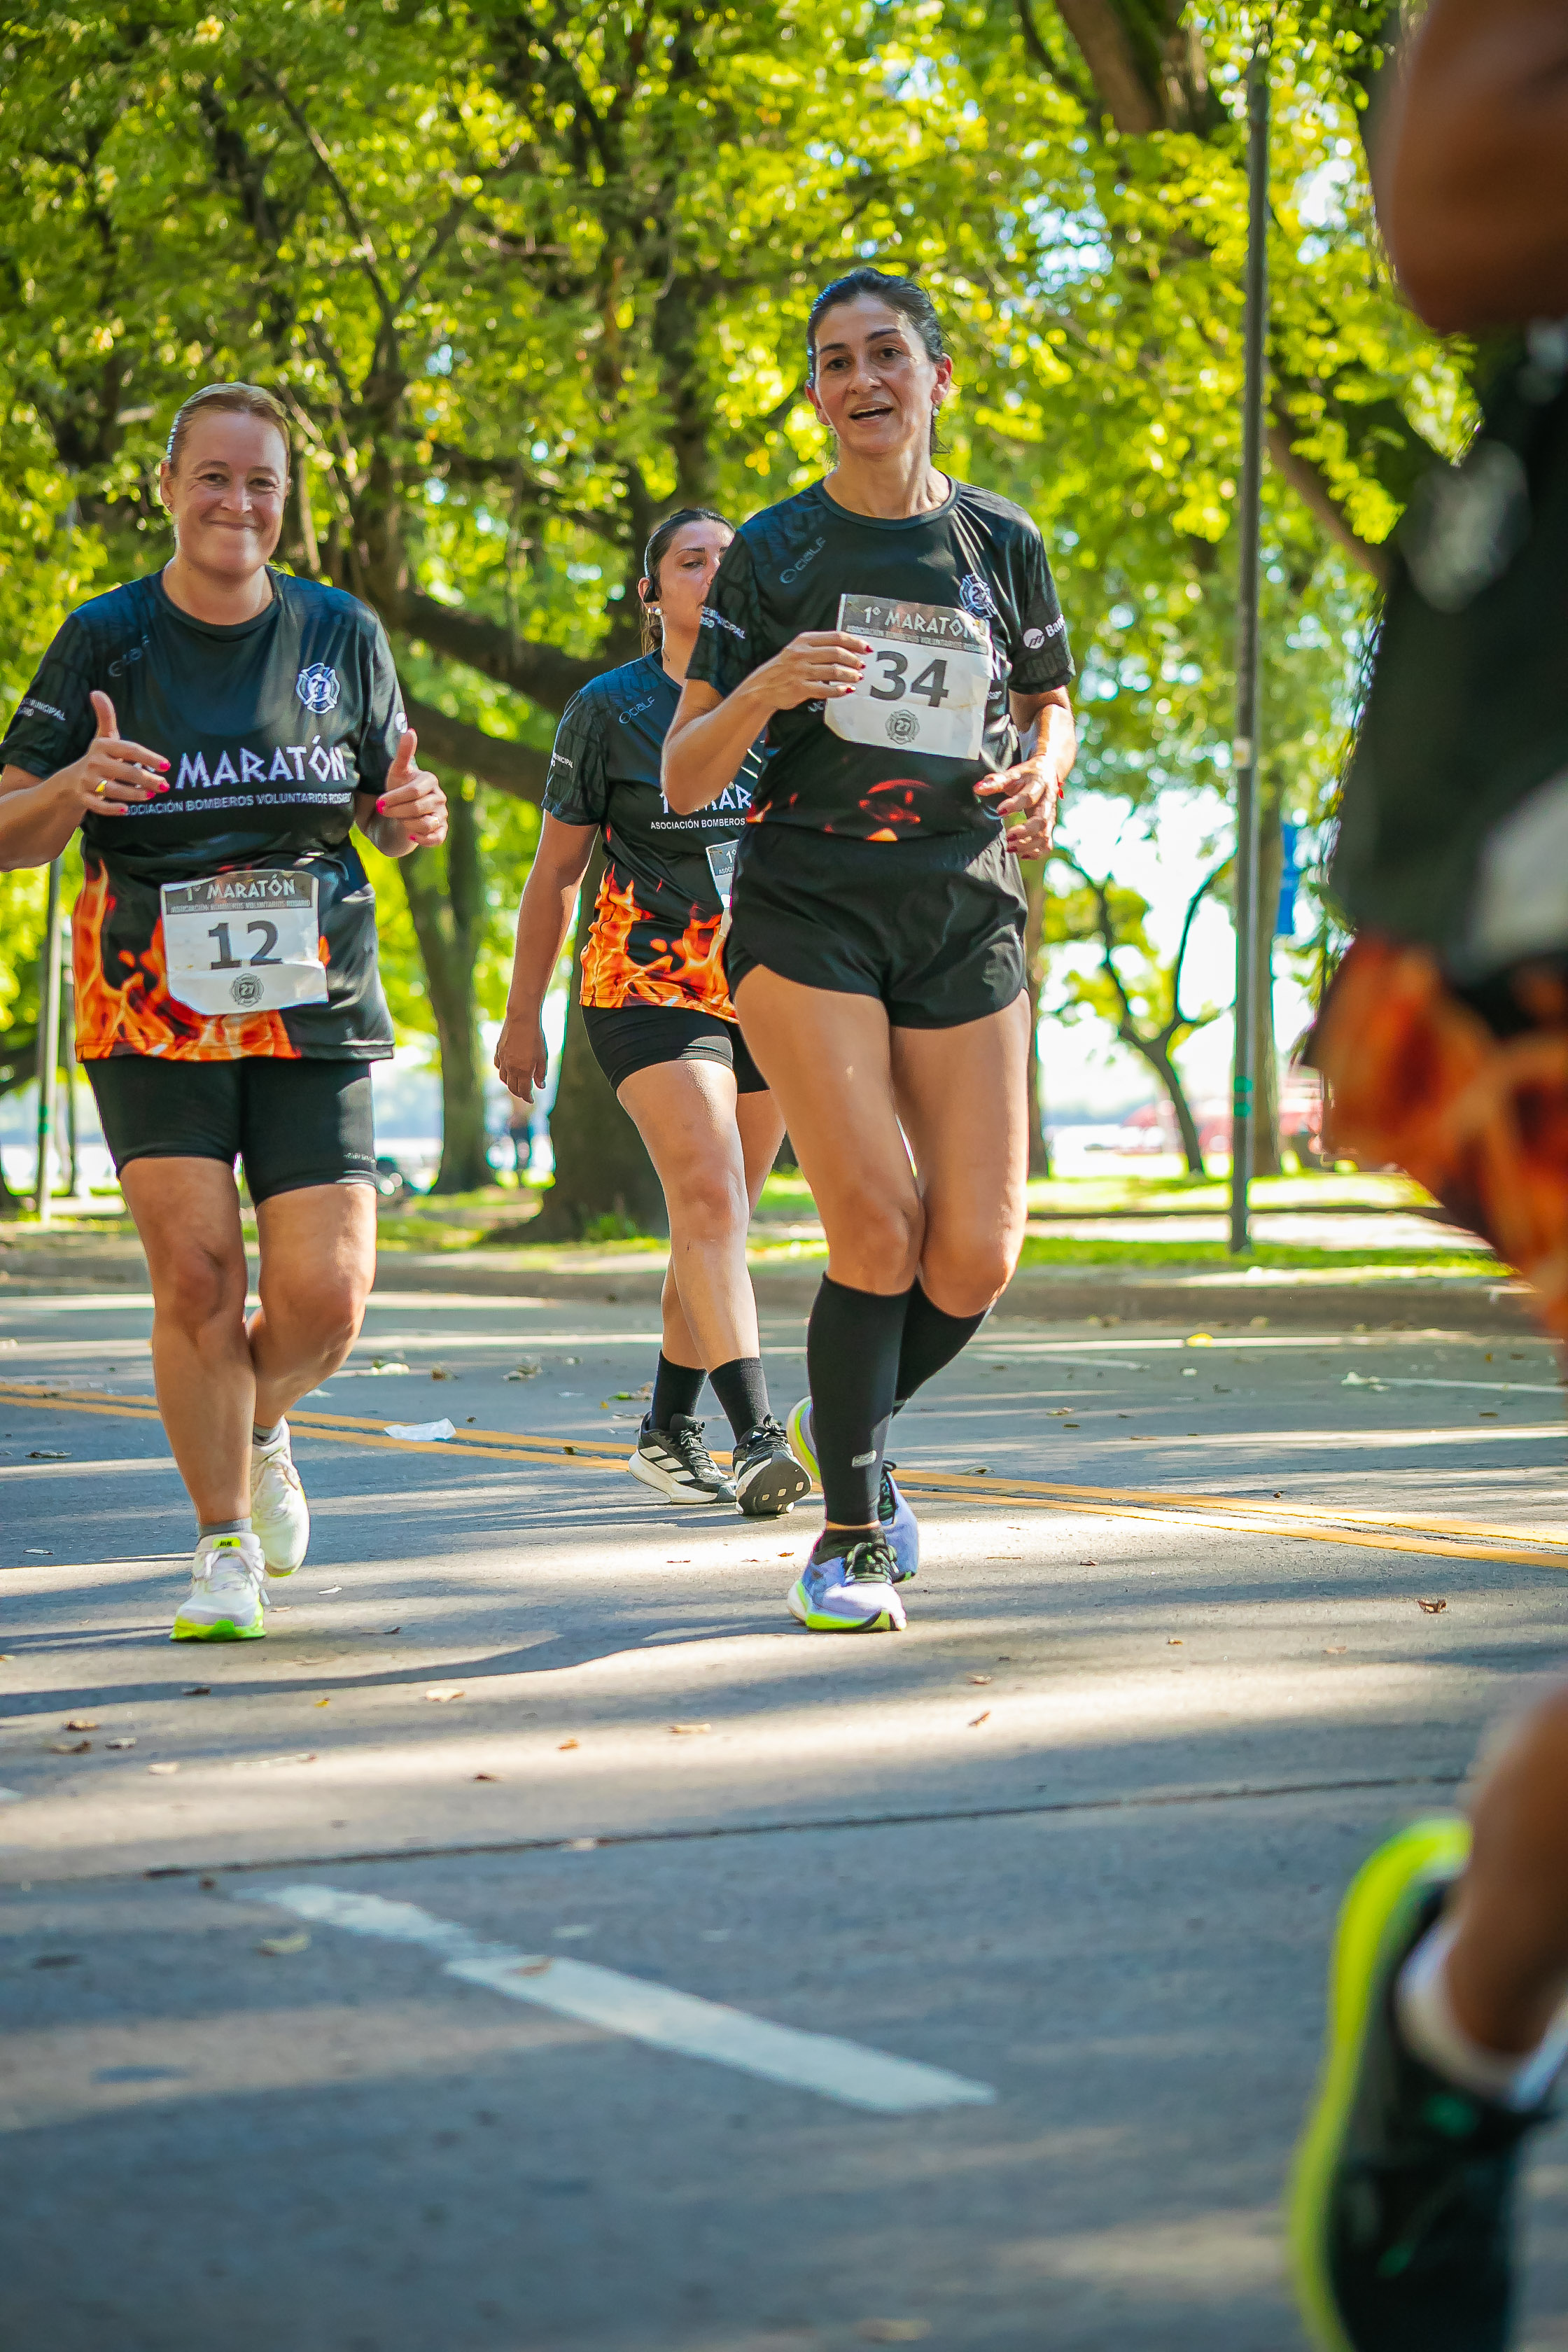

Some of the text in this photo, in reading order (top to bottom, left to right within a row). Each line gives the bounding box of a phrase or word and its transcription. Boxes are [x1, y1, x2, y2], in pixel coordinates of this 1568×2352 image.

[869, 650, 949, 708] 34
[175, 734, 347, 790] MARATÓN
[127, 799, 183, 816] OCIACIÓN
[185, 795, 254, 812] BOMBEROS
[256, 792, 328, 805] VOLUNTARIOS
[659, 791, 669, 814] 1
[650, 818, 746, 830] ASOCIACIÓN BOMBEROS
[718, 866, 735, 875] ASOCI
[206, 873, 296, 900] MARATÓN
[208, 920, 283, 970] 12
